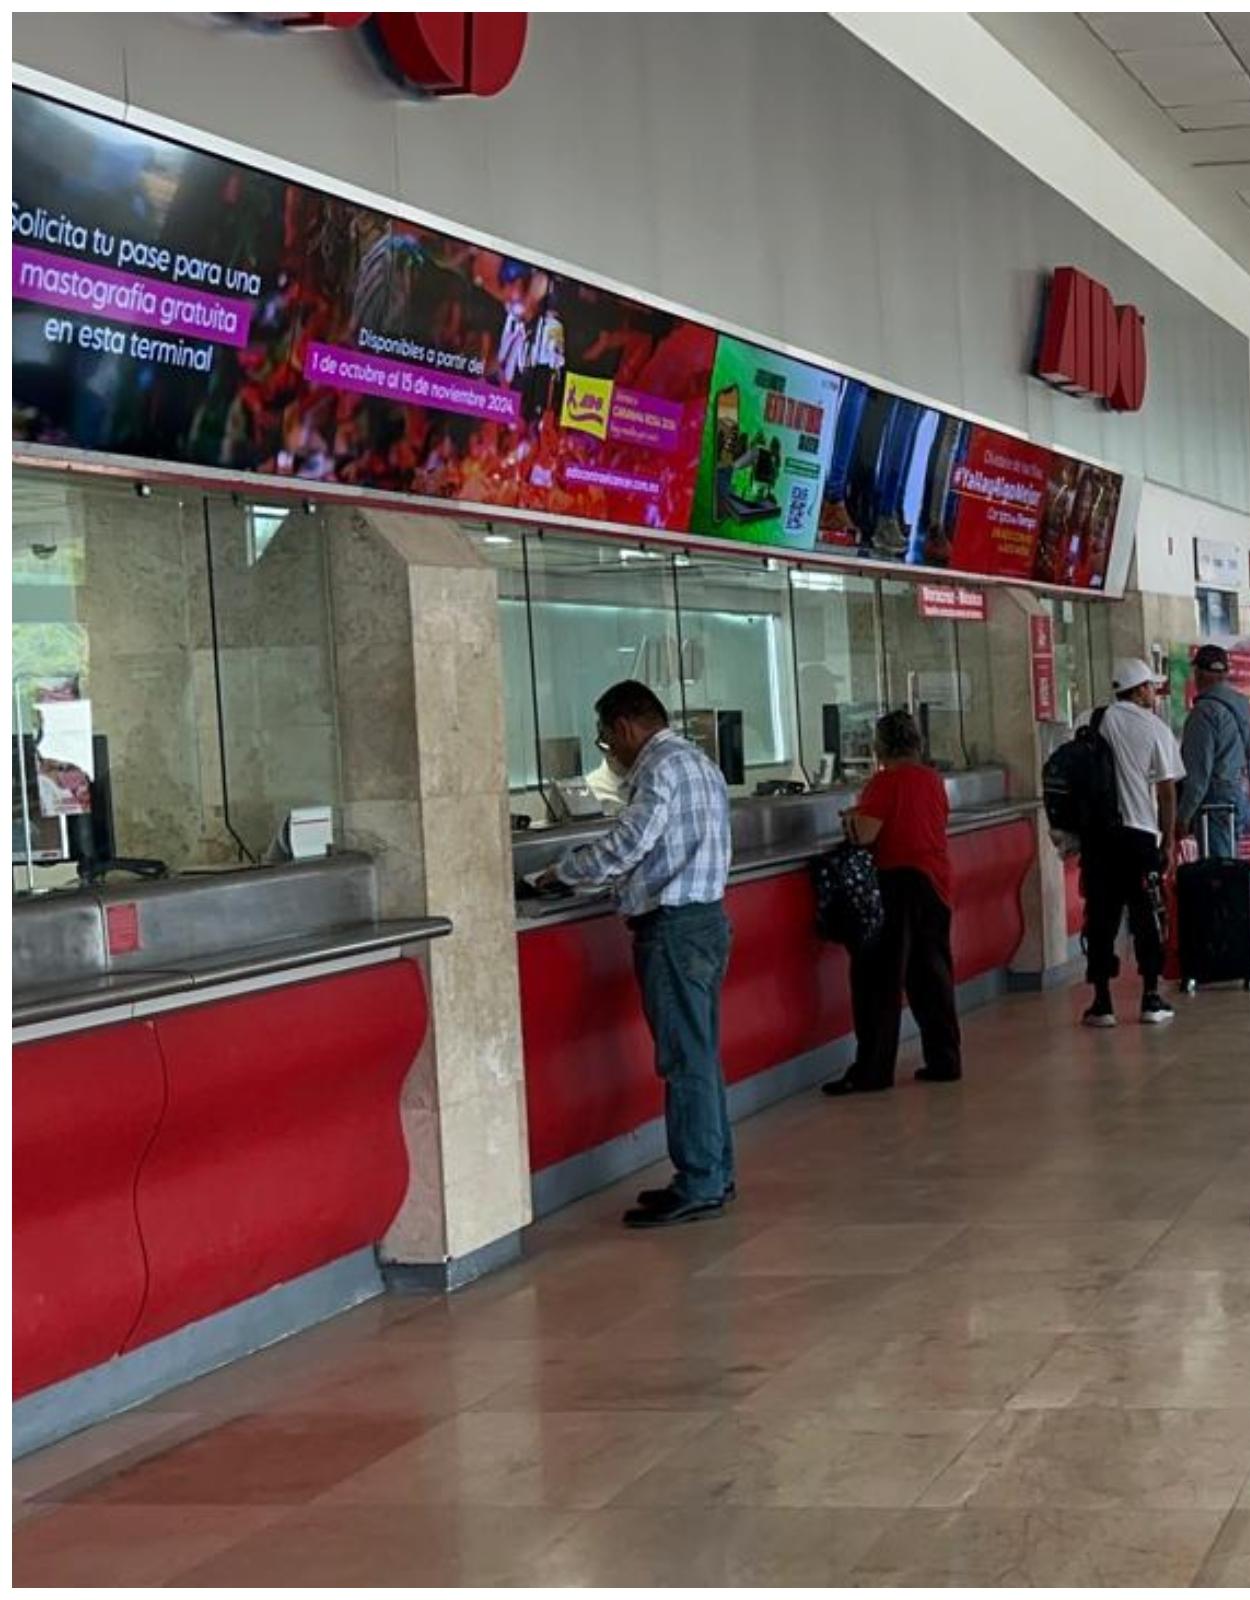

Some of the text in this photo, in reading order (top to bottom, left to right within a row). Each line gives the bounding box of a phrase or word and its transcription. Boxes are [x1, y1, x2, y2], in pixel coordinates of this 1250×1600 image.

[12, 202, 262, 295] Solicita tu pase para una
[160, 296, 238, 333] gratuita
[44, 317, 214, 372] en esta terminal
[358, 327, 425, 361] Disponibles
[312, 352, 319, 371] 1
[320, 355, 337, 375] de
[338, 361, 385, 386] octubre
[413, 375, 430, 397] de
[430, 383, 487, 409] noviembre
